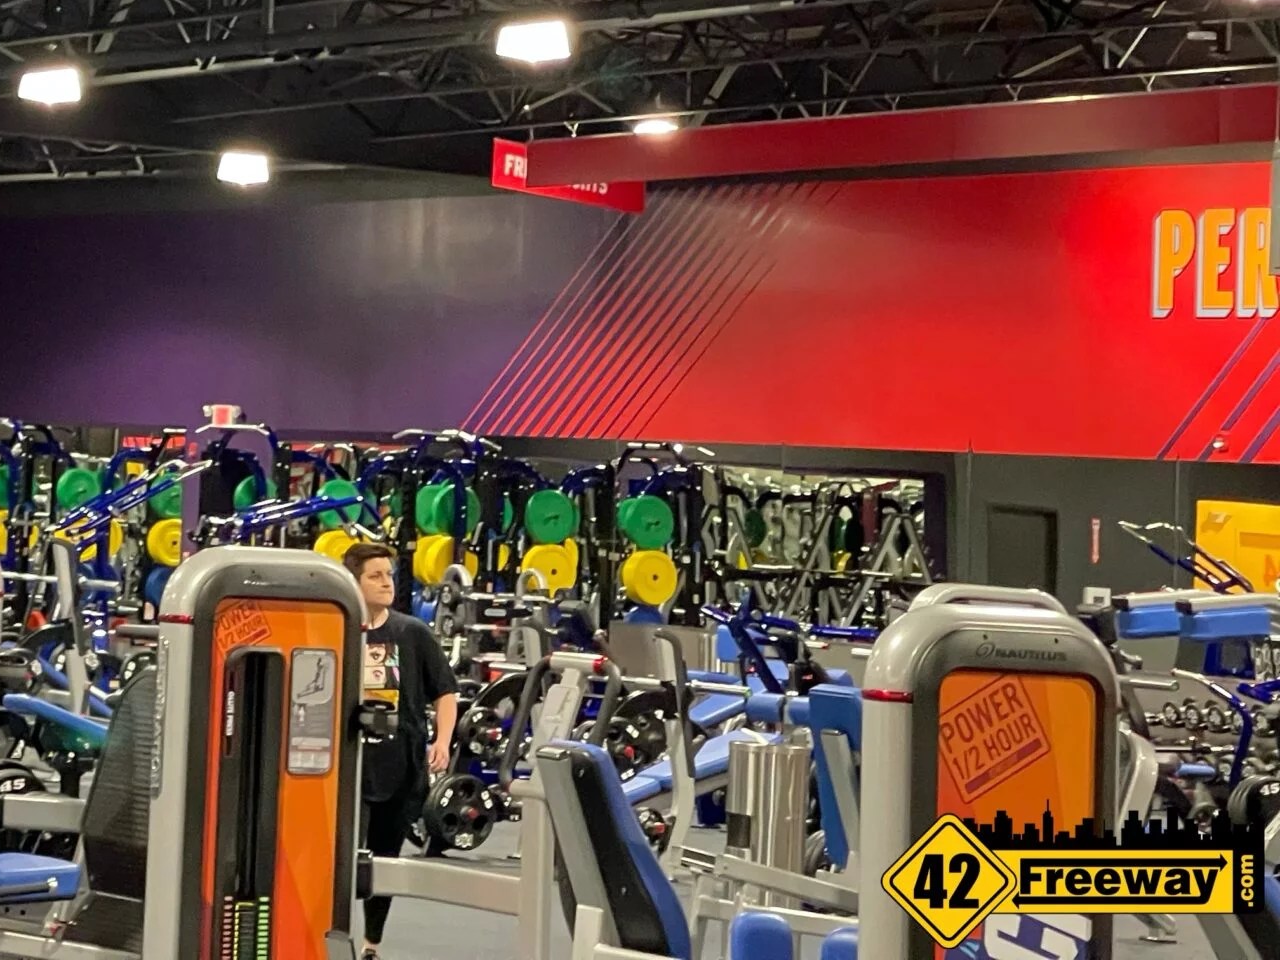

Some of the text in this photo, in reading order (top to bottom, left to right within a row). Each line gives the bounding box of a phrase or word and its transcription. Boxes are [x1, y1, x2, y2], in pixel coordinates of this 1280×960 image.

[1152, 208, 1280, 318] PER
[995, 648, 1068, 662] NAUTILUS
[940, 682, 1024, 754] POWER
[952, 714, 1037, 780] 1/2 HOUR
[0, 778, 26, 792] 45
[1260, 783, 1280, 795] 45
